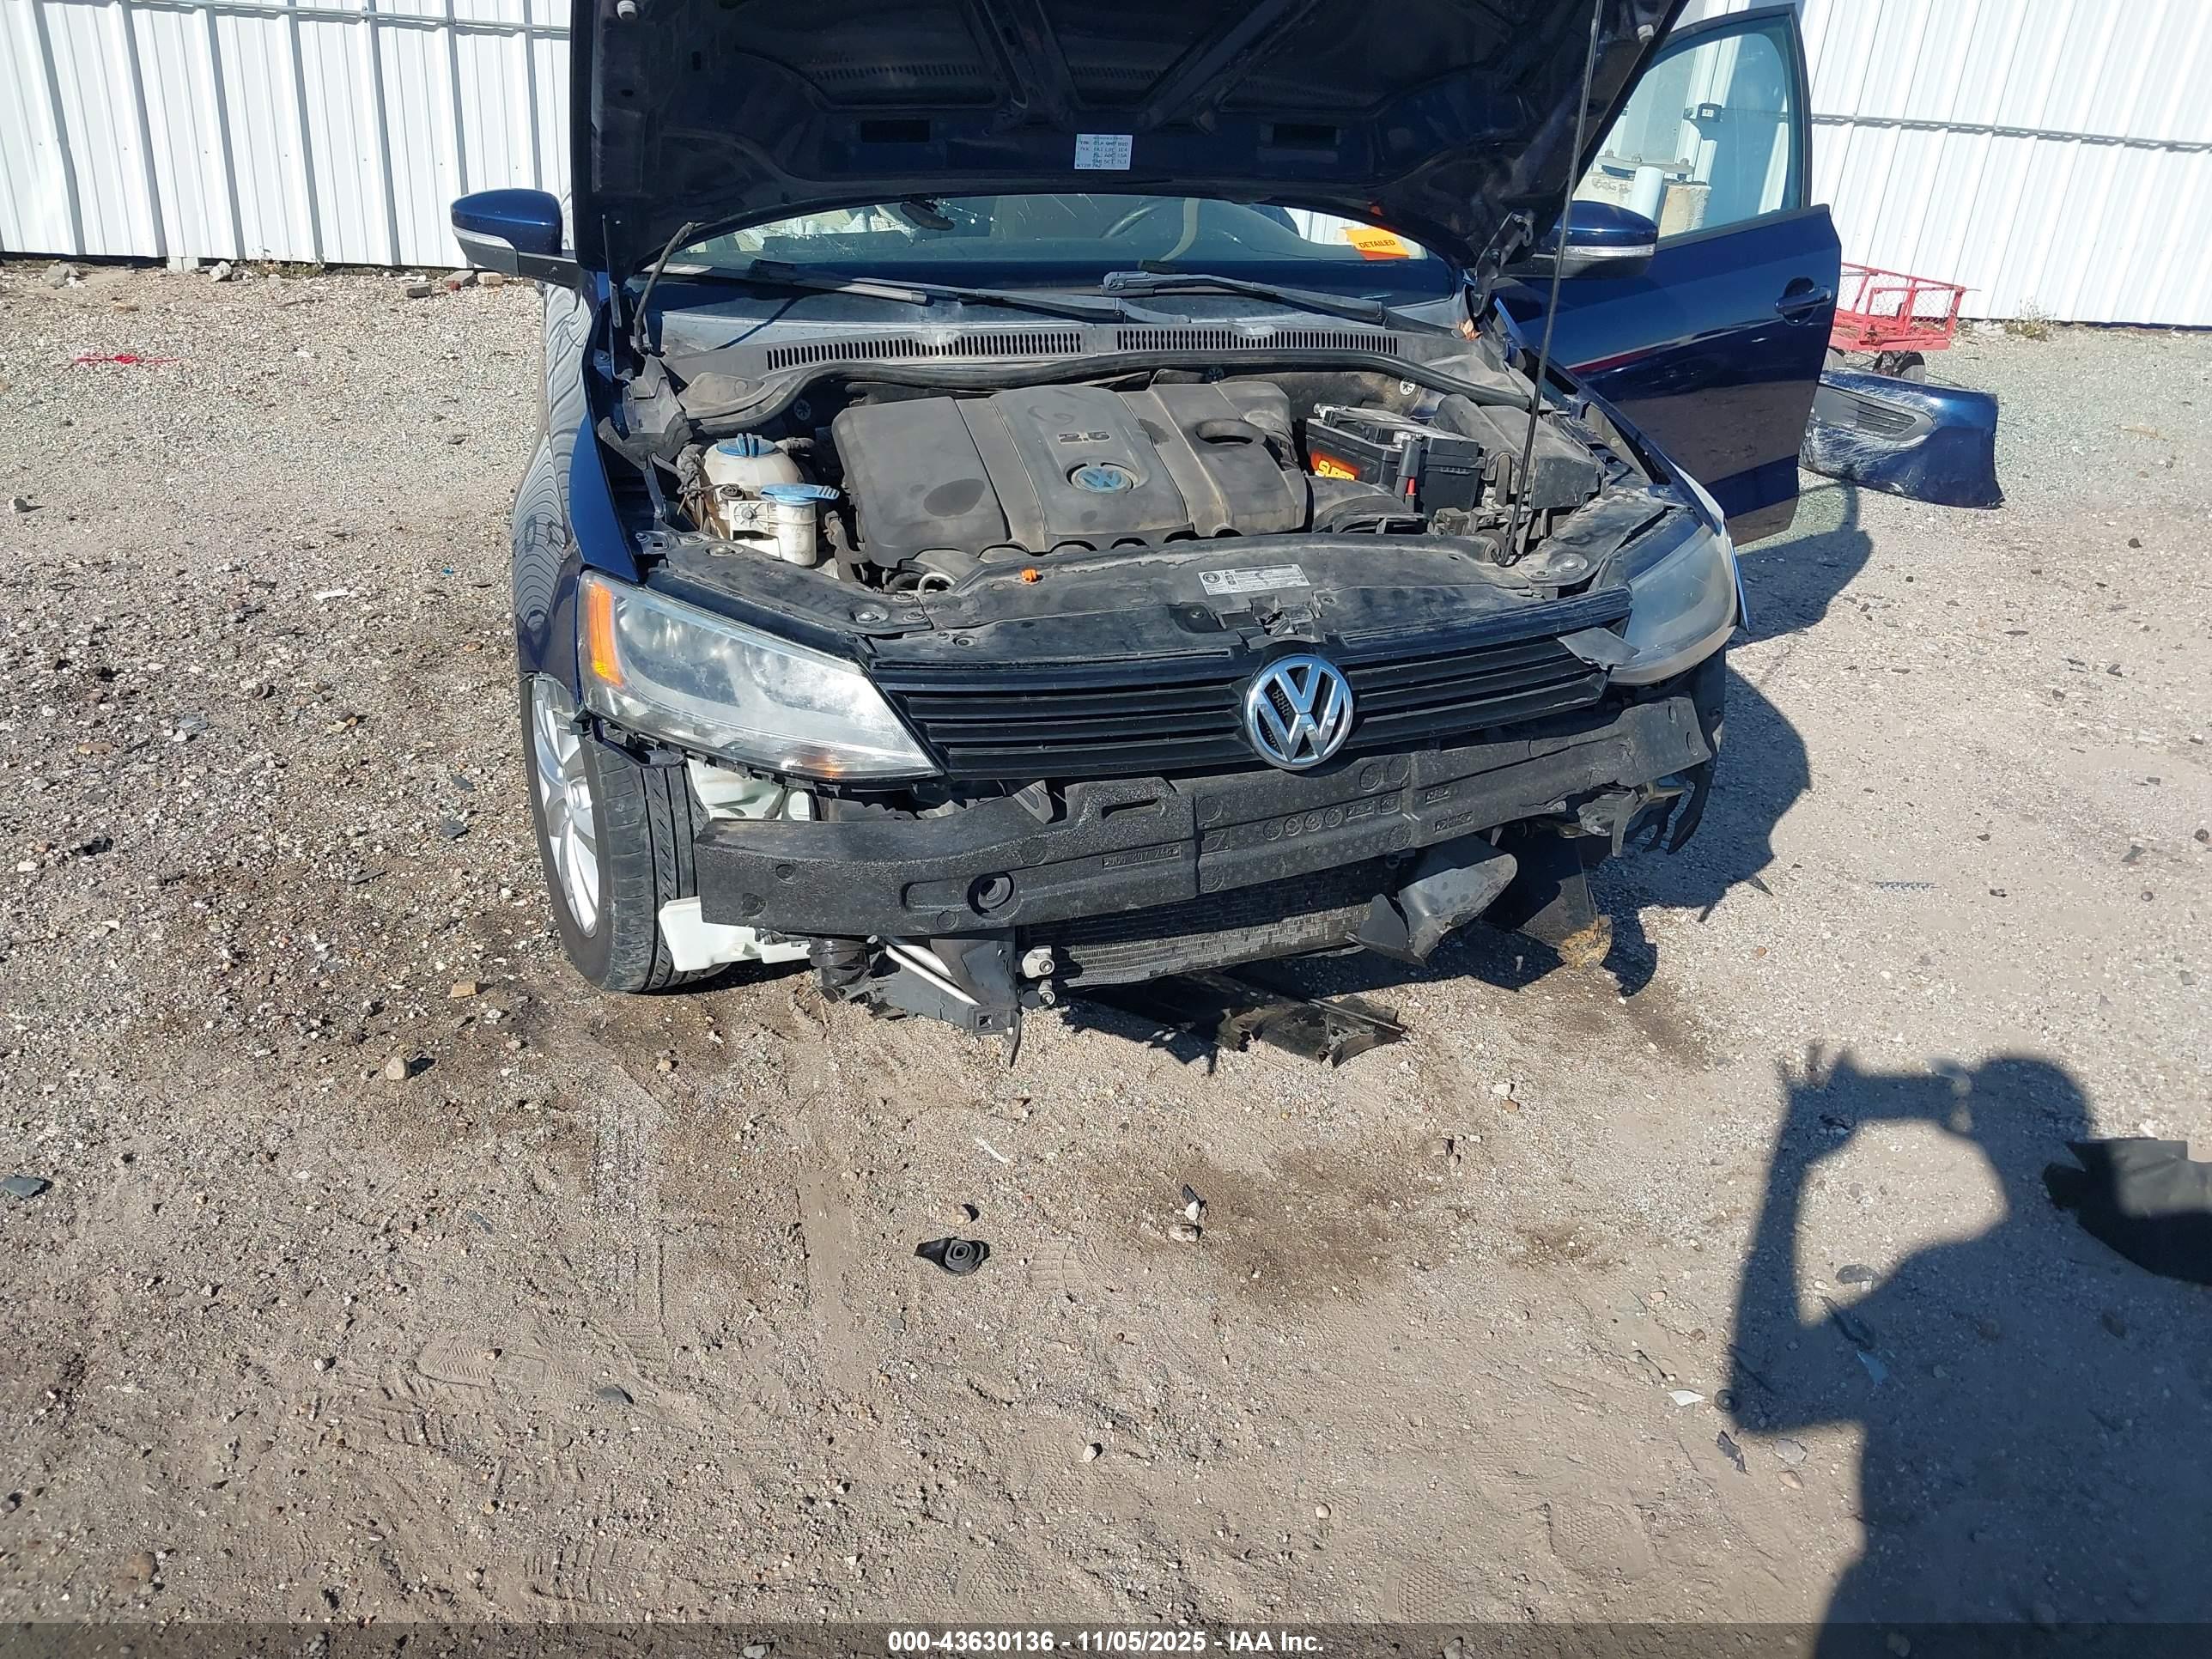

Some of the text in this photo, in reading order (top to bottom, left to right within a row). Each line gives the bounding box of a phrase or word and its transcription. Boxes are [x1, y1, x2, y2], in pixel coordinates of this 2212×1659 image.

[1358, 239, 1396, 249] DETAILED
[1058, 431, 1110, 444] 2.5
[1244, 653, 1354, 770] VW
